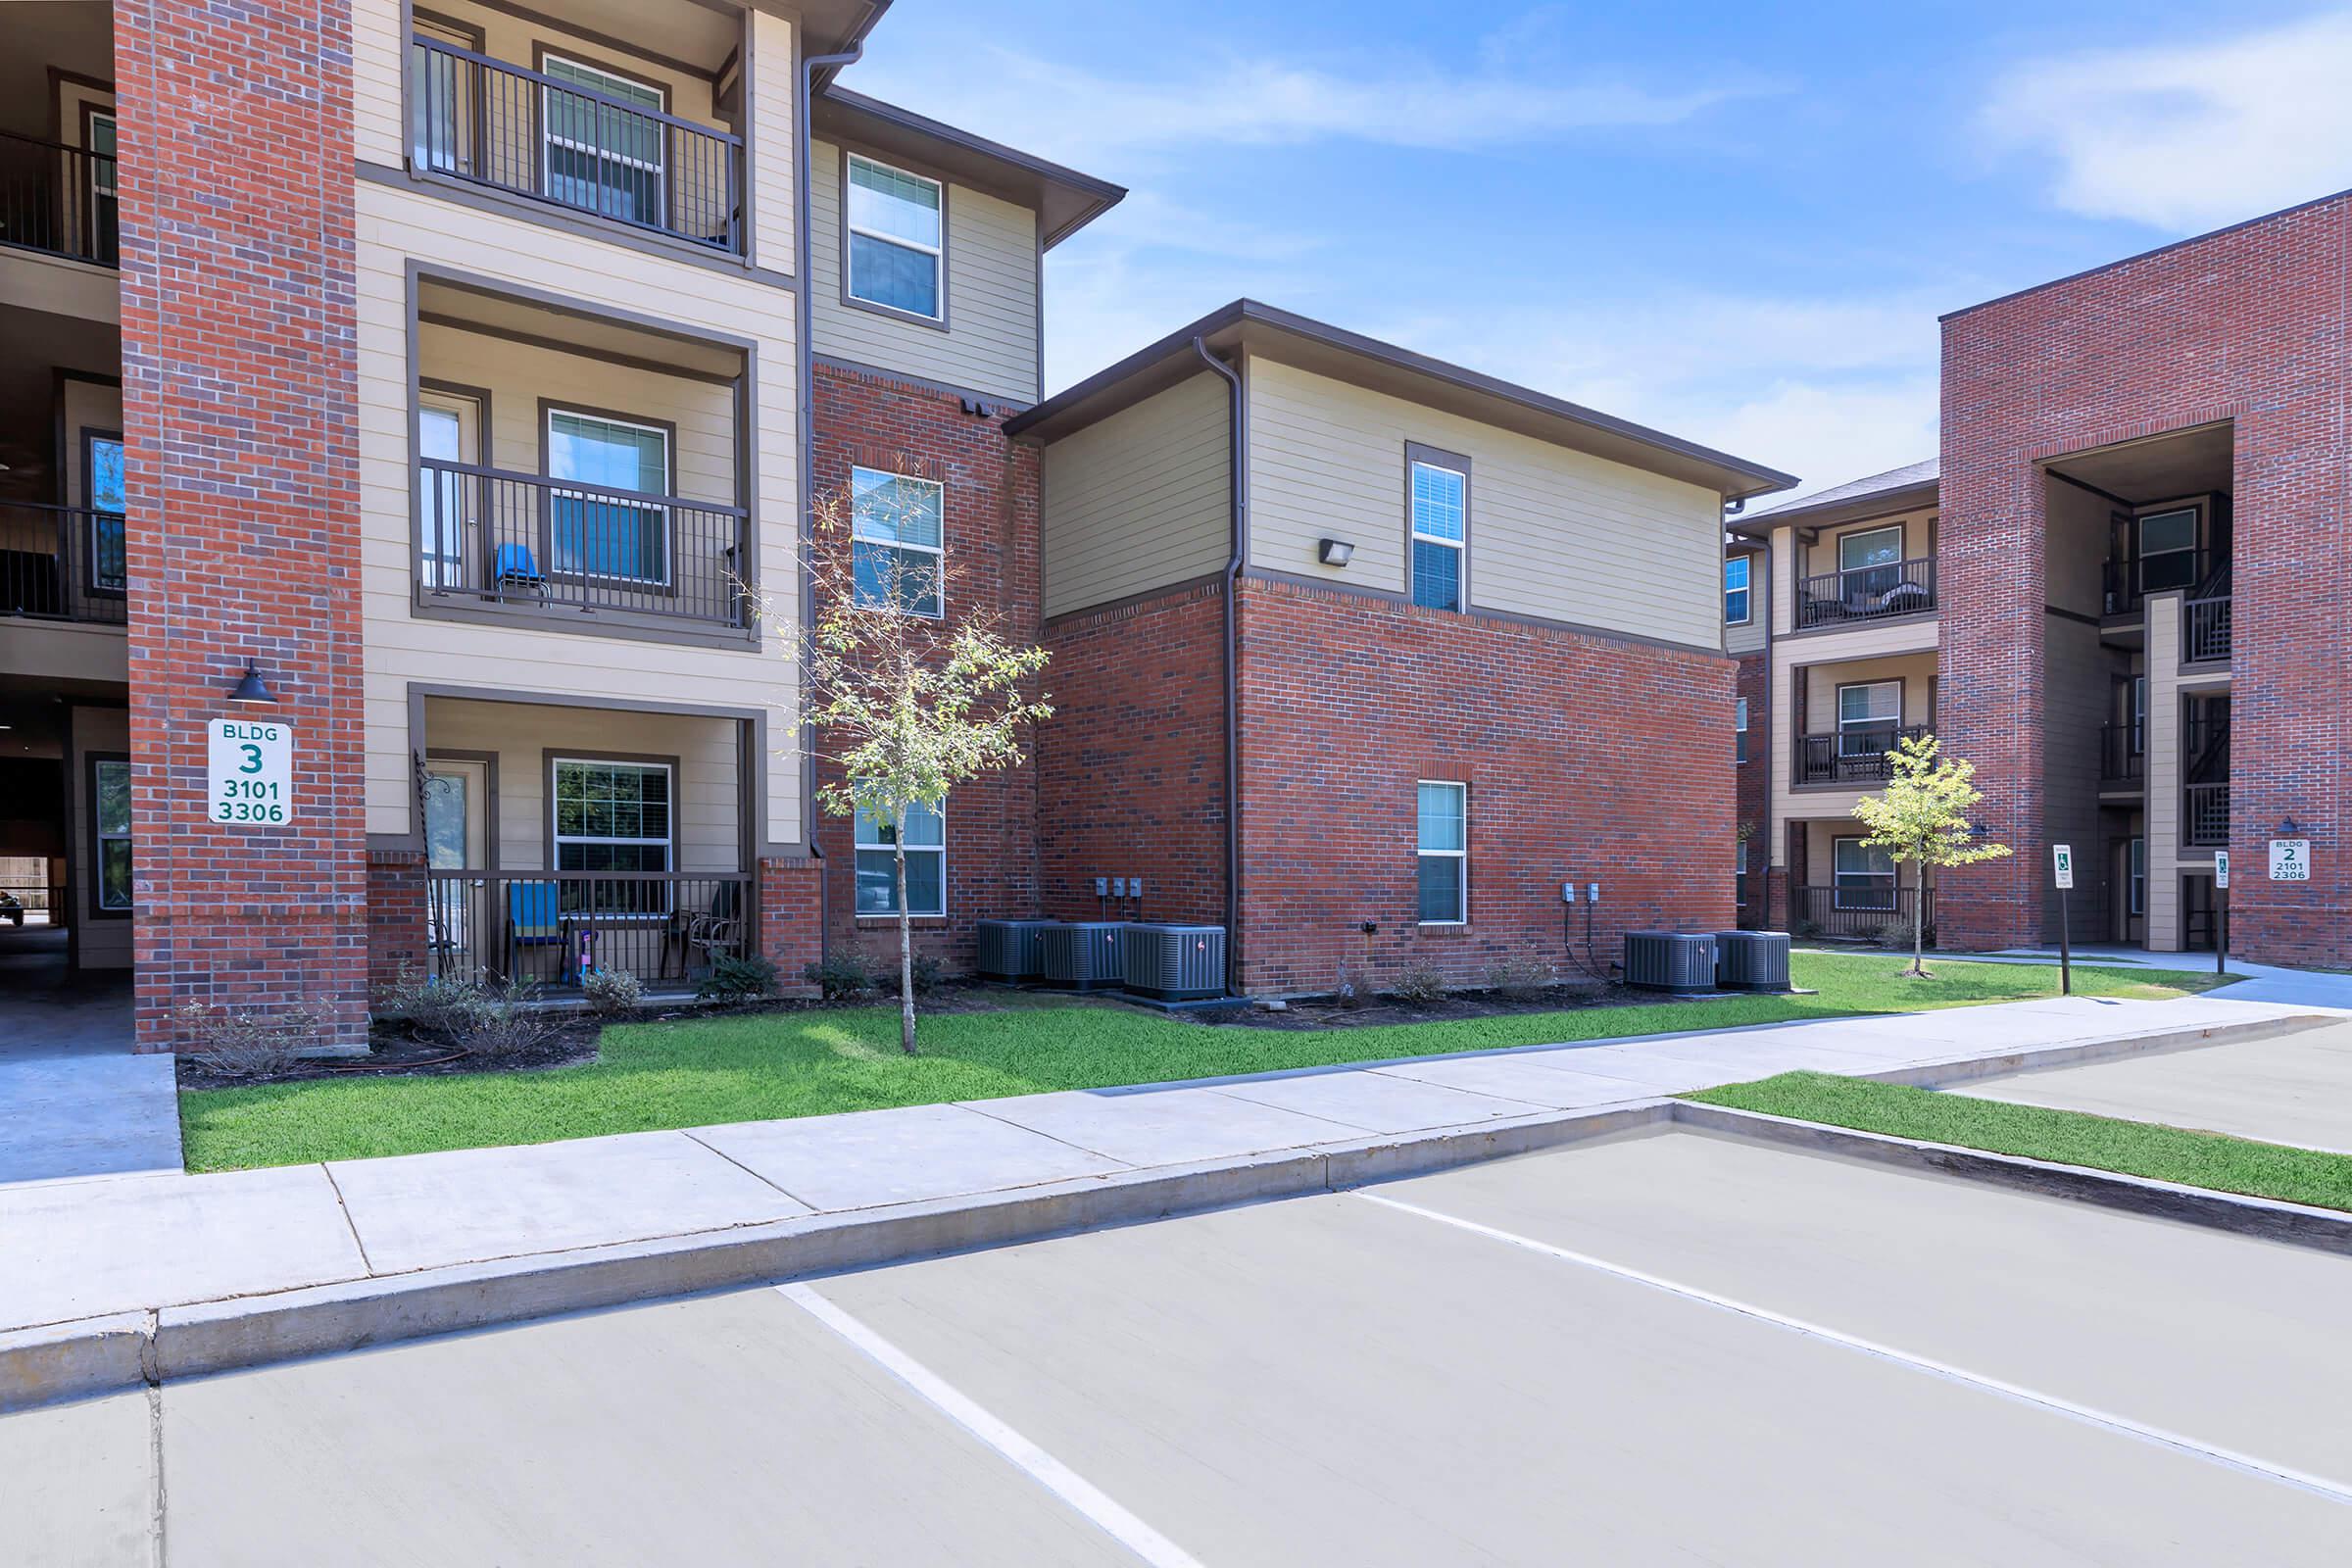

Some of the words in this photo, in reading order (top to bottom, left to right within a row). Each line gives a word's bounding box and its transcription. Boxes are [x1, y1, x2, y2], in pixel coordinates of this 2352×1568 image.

[223, 724, 277, 741] BLDG
[238, 744, 263, 773] 3
[223, 779, 277, 800] 3101
[218, 802, 283, 822] 3306
[2283, 848, 2295, 860] 2
